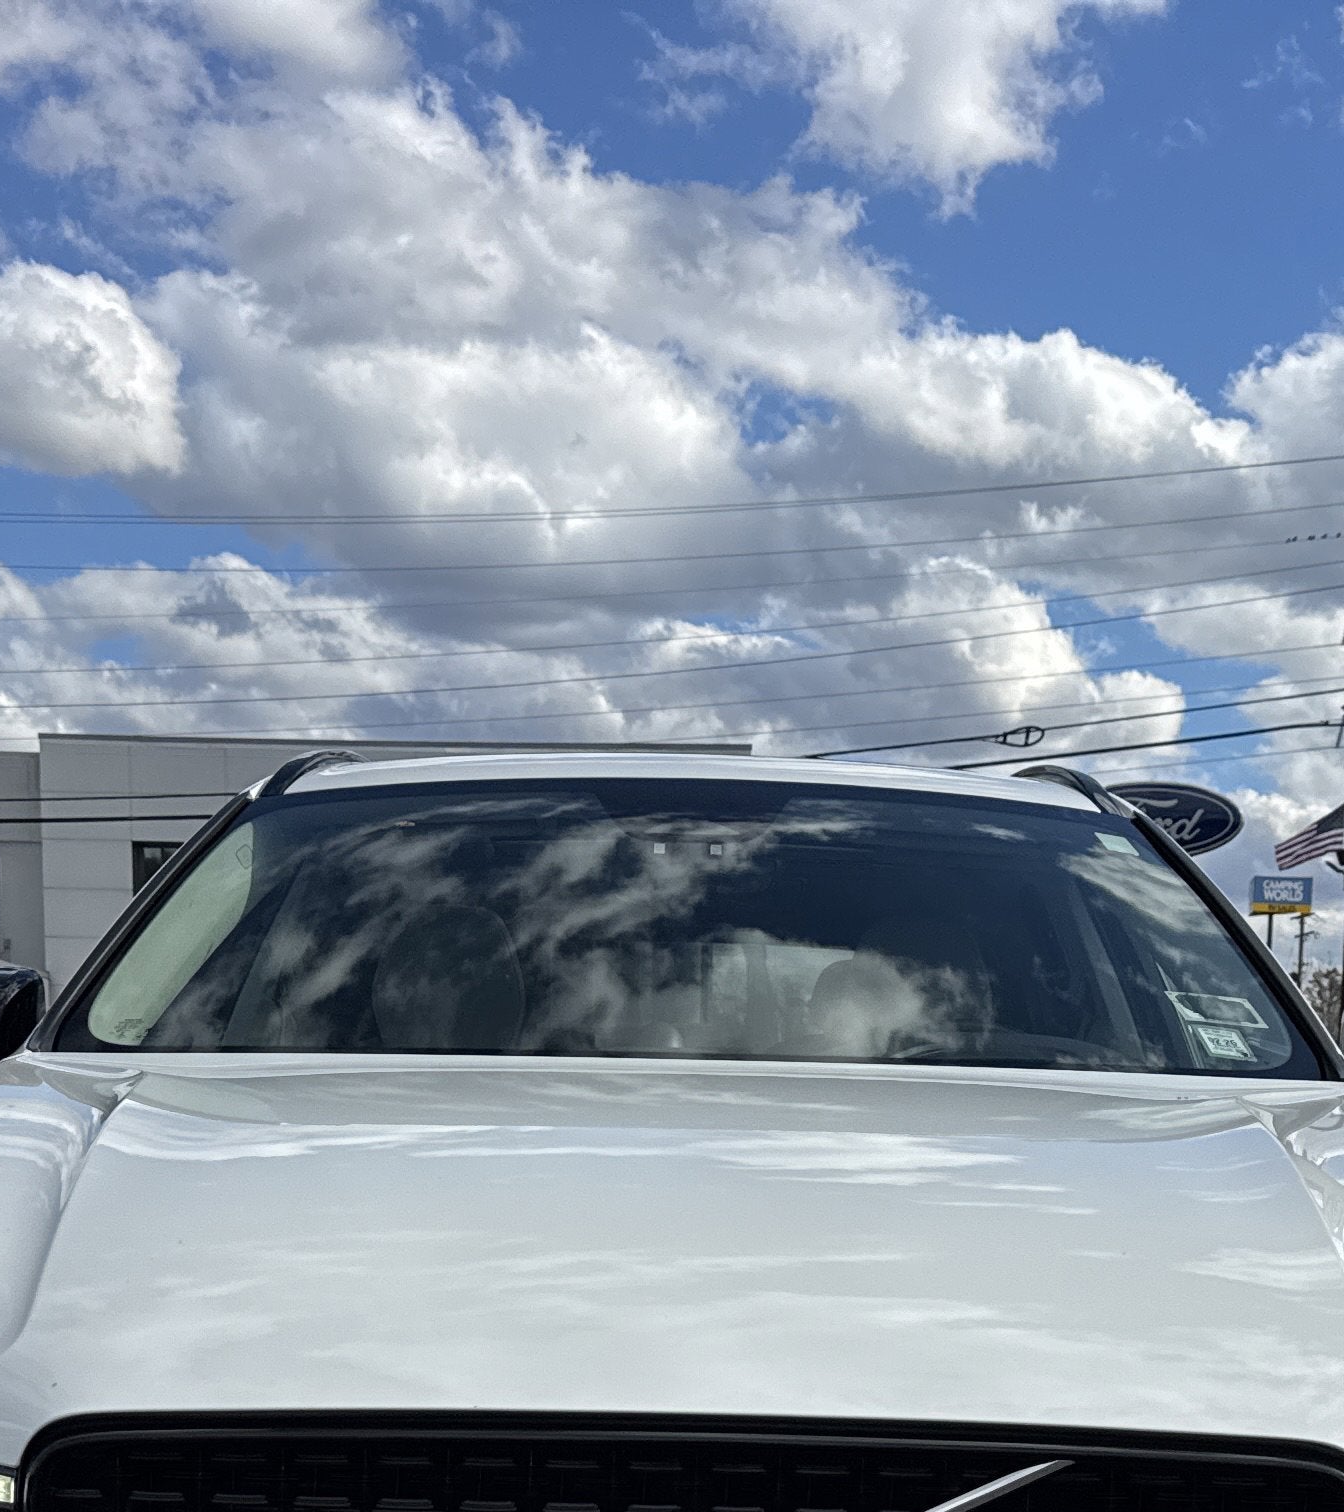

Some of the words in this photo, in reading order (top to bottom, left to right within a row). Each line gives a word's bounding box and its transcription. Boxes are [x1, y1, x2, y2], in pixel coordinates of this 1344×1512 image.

[1124, 796, 1205, 841] Frd
[1263, 879, 1304, 891] CAMPING
[1264, 889, 1304, 901] WORLD
